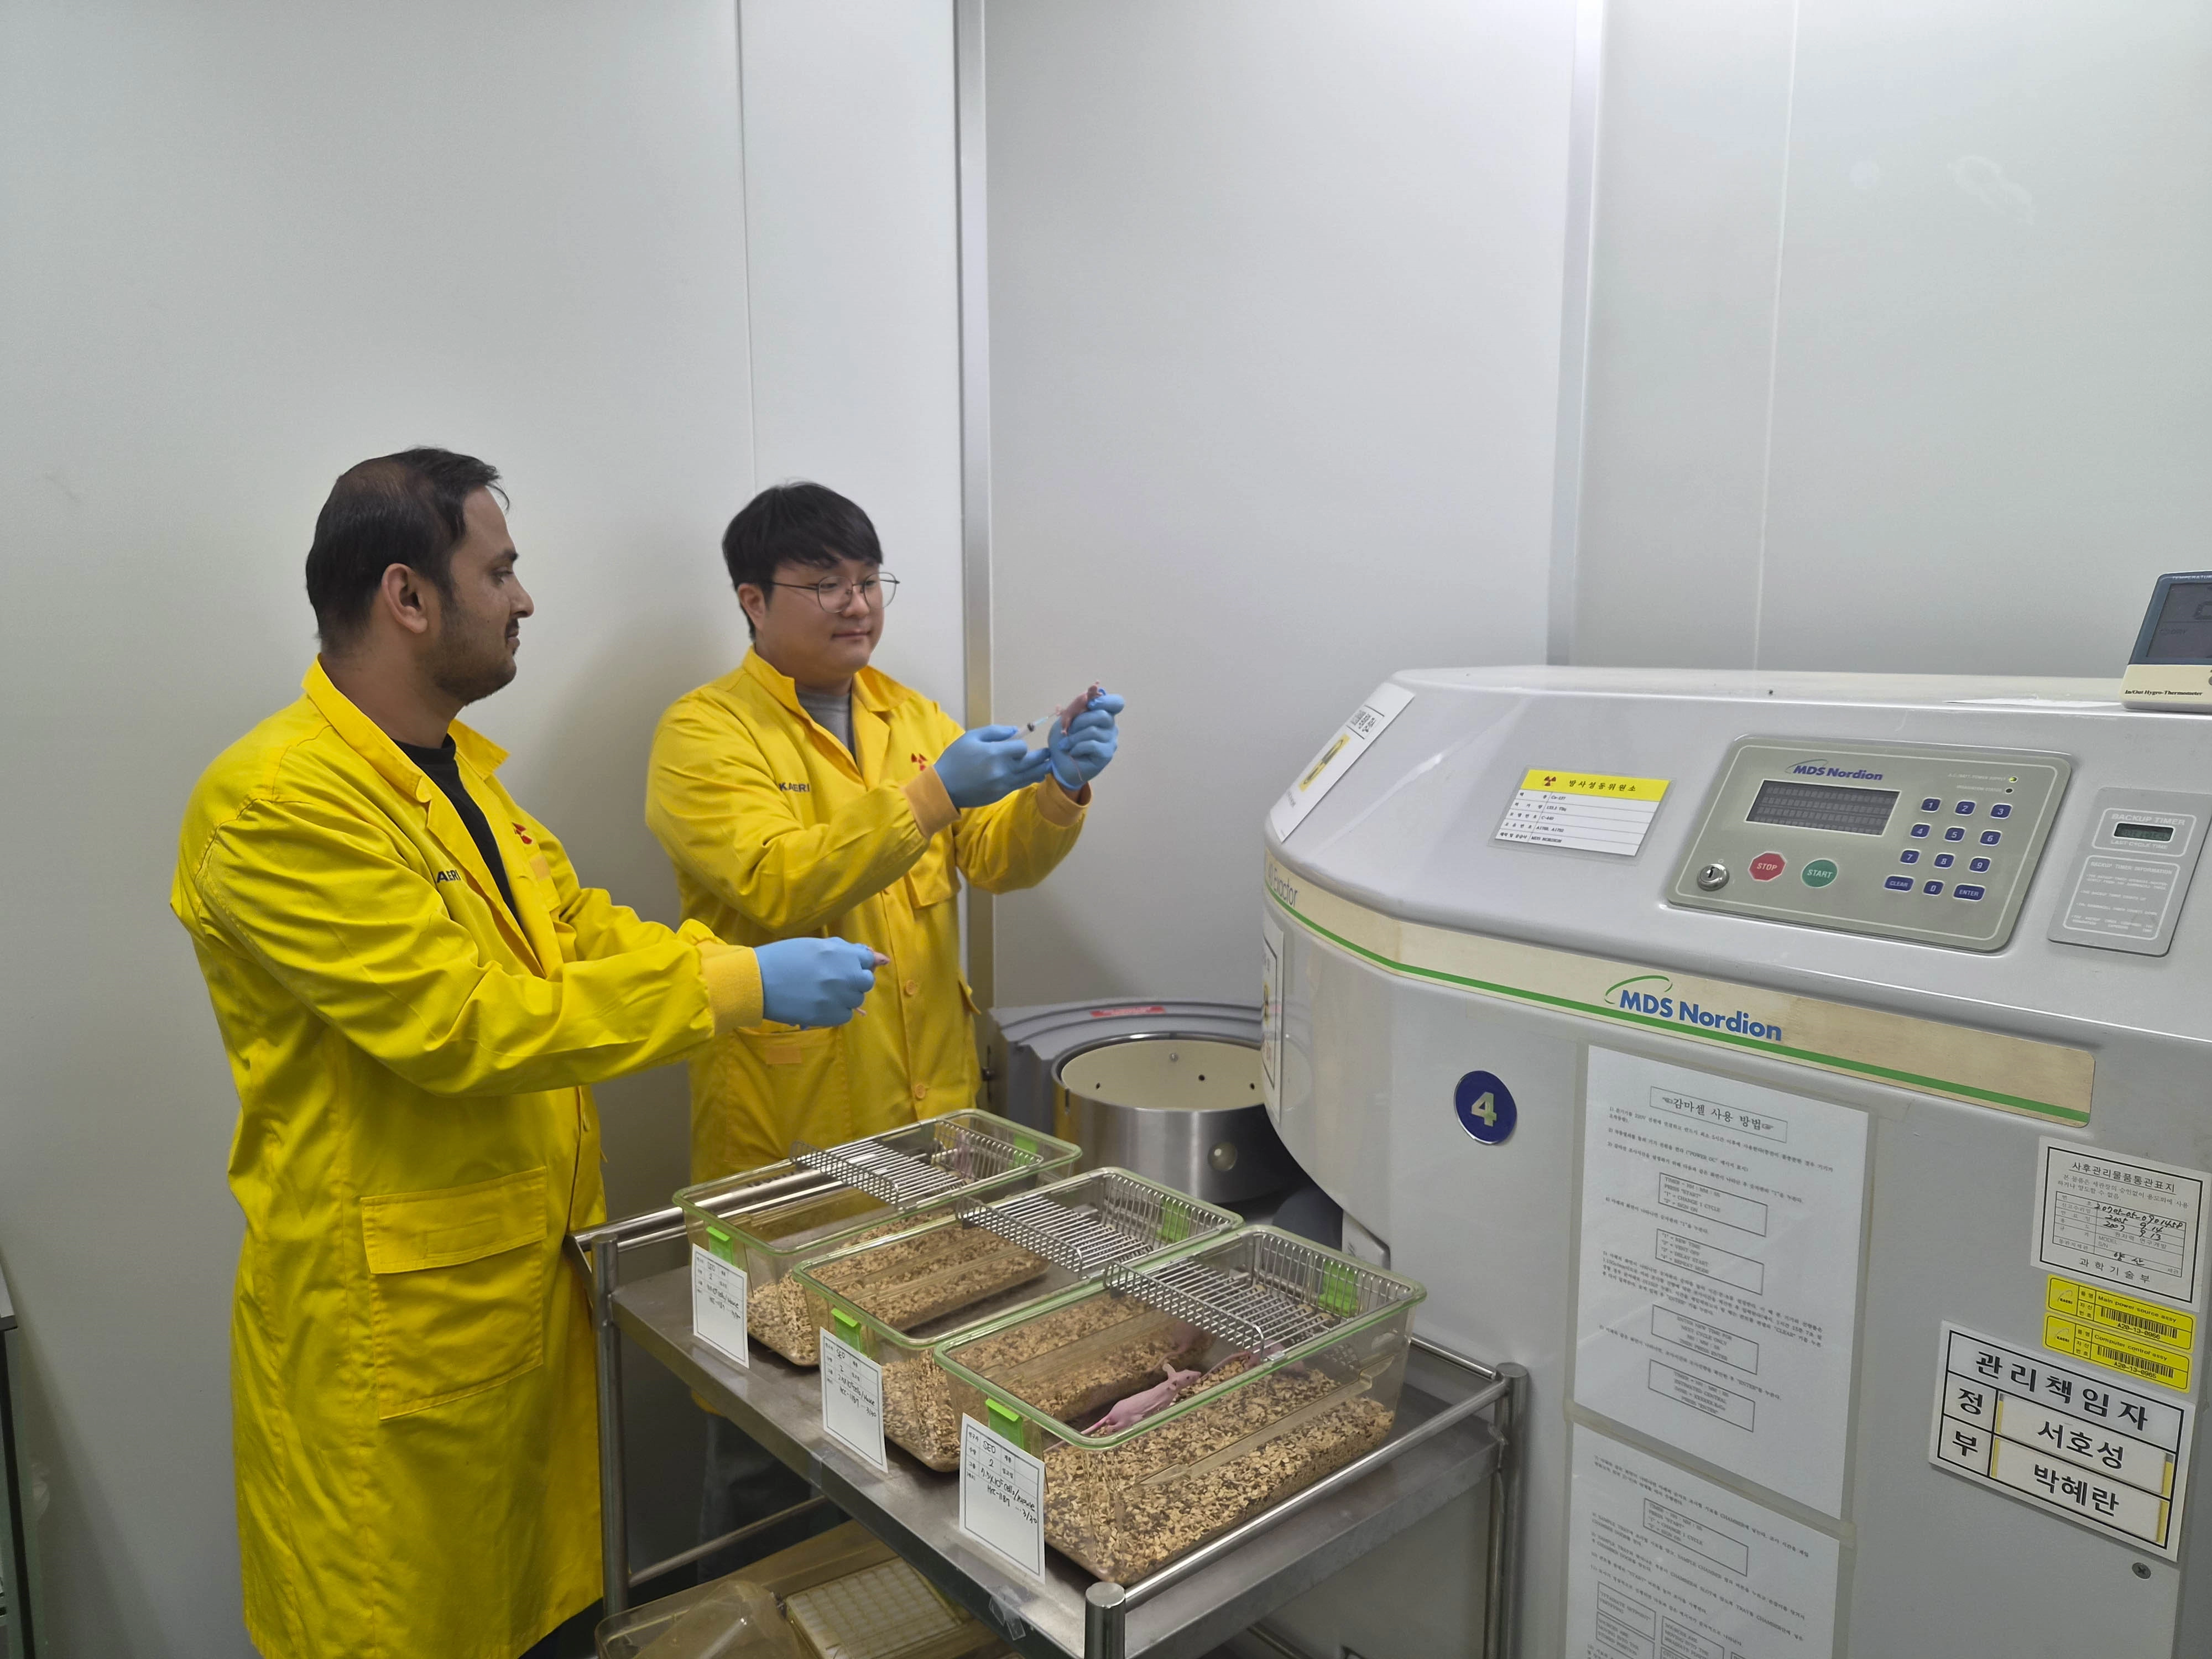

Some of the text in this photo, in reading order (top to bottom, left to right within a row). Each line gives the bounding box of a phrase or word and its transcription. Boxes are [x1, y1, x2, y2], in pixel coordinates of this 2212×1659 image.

[1568, 779, 1637, 792] 방사성동위원소
[1793, 764, 1884, 781] MDS Nordion
[779, 782, 810, 792] KAERI
[2111, 813, 2186, 826] BACKUP TIMER
[437, 869, 461, 883] AERI
[1756, 862, 1778, 871] STOP
[1807, 869, 1834, 879] START
[1619, 989, 1782, 1042] MDS Nordion
[1470, 1091, 1497, 1127] 4
[1673, 1098, 1761, 1130] 감마셀 사용 방법
[2072, 1161, 2176, 1193] 사후관리물품통관표지
[2079, 1257, 2150, 1284] 과학기술부
[2098, 1295, 2178, 1324] Main power source assy
[2117, 1322, 2161, 1340] A20-13-0966
[2094, 1333, 2168, 1361] Computer control assy
[2114, 1360, 2157, 1379] A20-13-0965
[1957, 1387, 1984, 1415] 정
[1976, 1350, 2148, 1431] 관리책임자
[983, 1440, 996, 1454] SEO
[1952, 1431, 1978, 1457] 부
[2037, 1421, 2124, 1470] 서호성
[989, 1458, 994, 1468] 2
[2033, 1464, 2120, 1517] 박혜란
